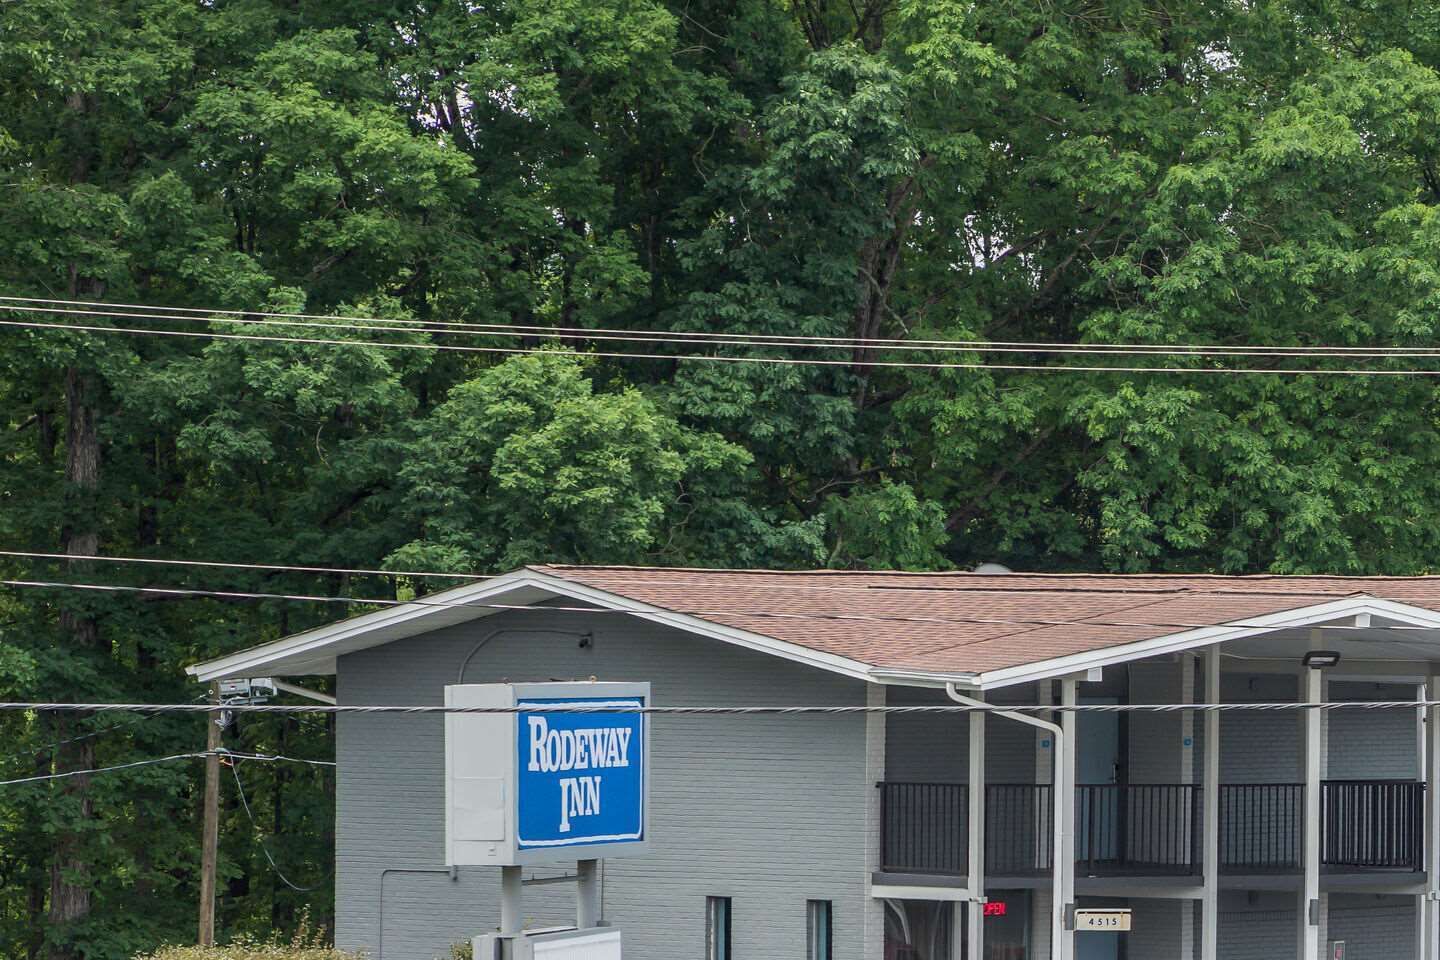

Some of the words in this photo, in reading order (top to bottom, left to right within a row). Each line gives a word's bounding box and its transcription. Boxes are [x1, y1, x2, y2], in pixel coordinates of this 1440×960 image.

[528, 715, 632, 772] RODEWAY
[559, 775, 601, 832] INN
[1088, 917, 1117, 926] 4515
